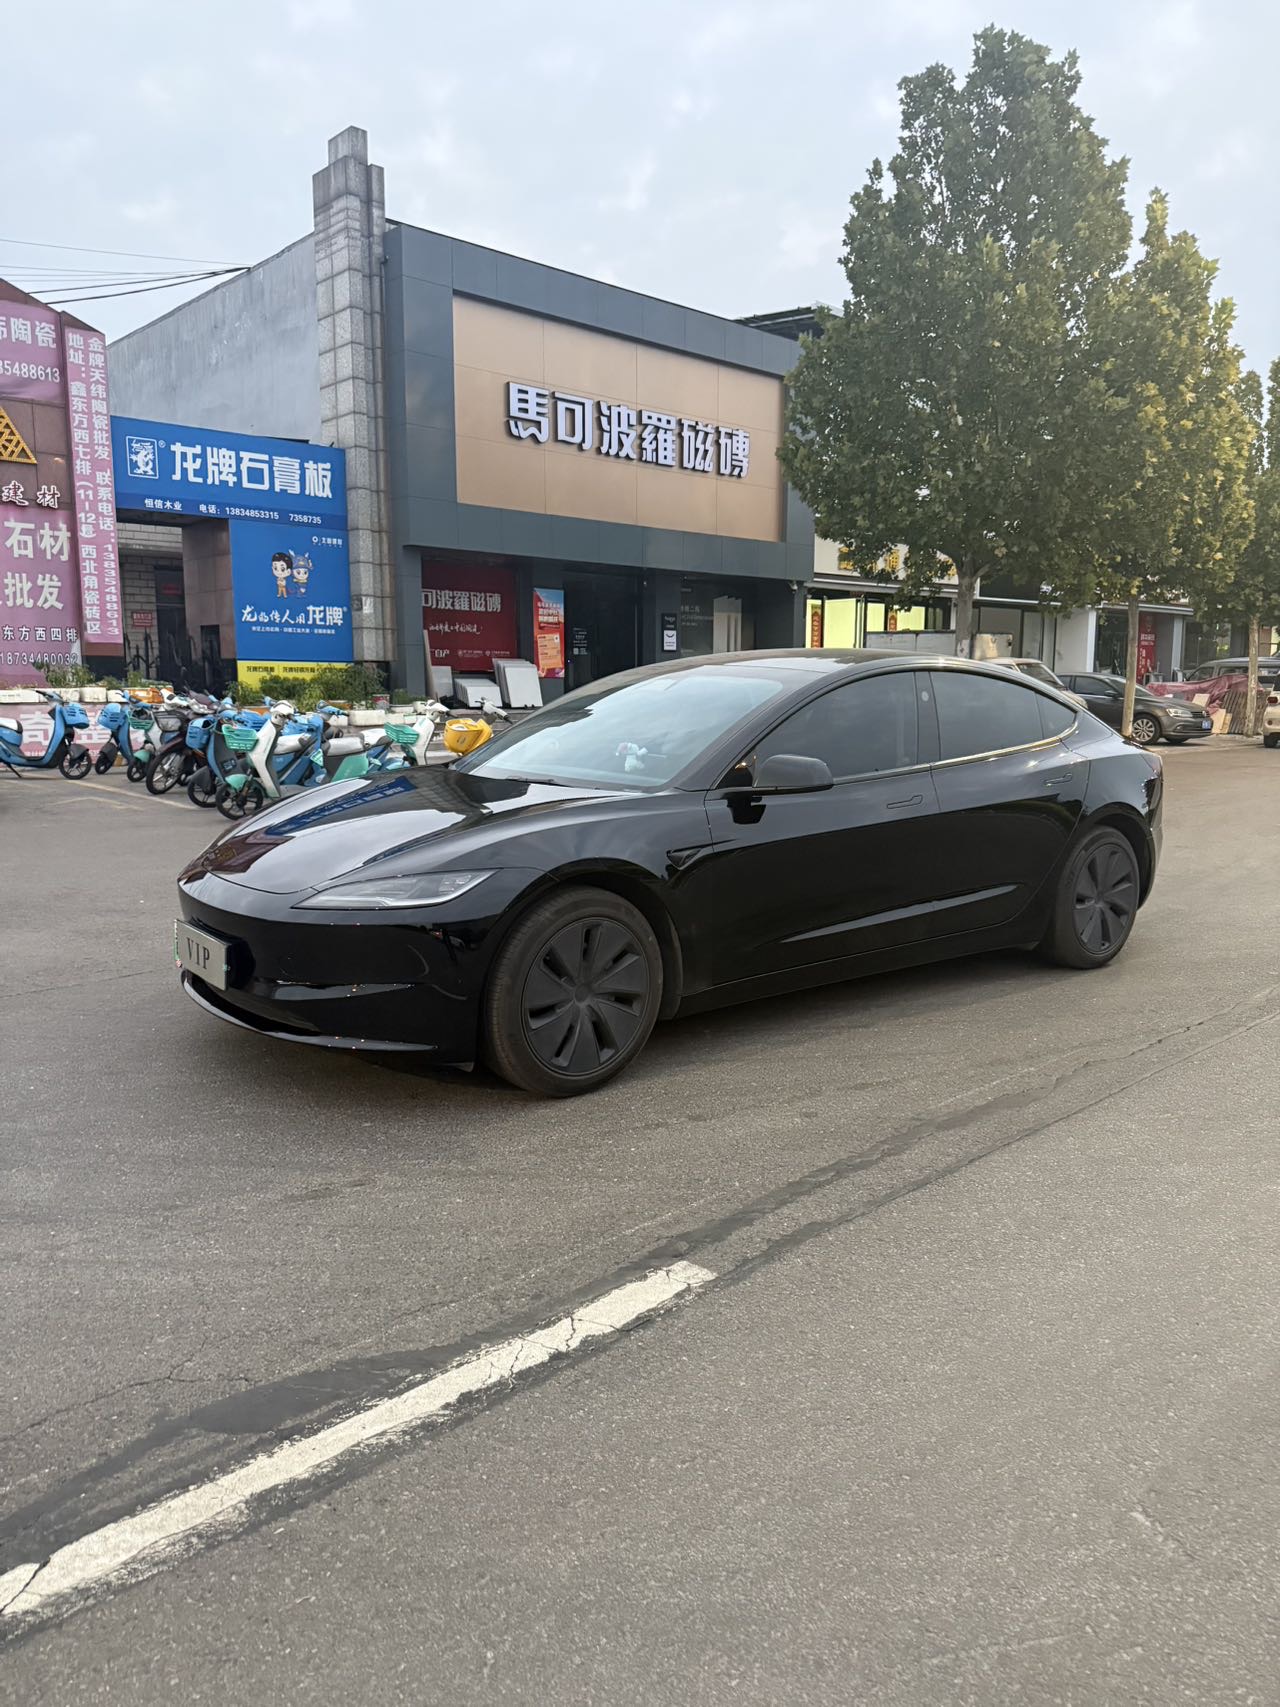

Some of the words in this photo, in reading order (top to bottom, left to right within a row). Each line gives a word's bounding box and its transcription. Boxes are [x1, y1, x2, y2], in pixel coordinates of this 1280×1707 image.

[505, 381, 750, 478] 馬可波羅磁磚
[170, 442, 333, 499] 龙牌石膏板
[2, 480, 60, 508] 建材
[144, 498, 182, 511] 恒信木业
[225, 507, 279, 520] 13834853315
[288, 513, 322, 525] 7358735
[4, 520, 71, 562] 石材
[3, 571, 64, 610] 批发
[2, 625, 78, 641] 东方西四排
[187, 937, 210, 970] VIP
